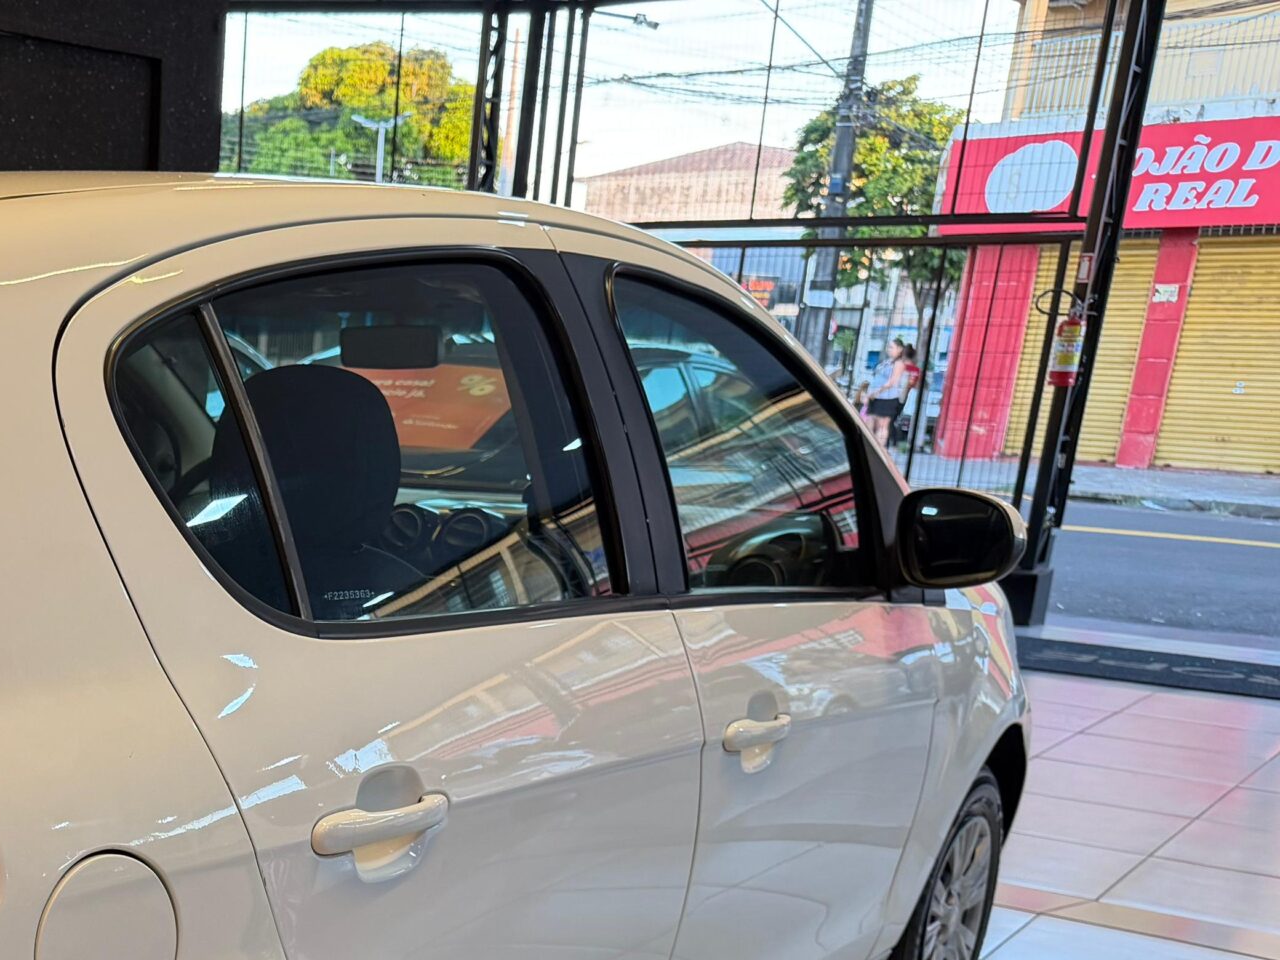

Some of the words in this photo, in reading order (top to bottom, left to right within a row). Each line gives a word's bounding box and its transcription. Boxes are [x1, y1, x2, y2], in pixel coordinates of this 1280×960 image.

[1132, 134, 1241, 177] OJÃO
[1242, 140, 1280, 170] D
[1132, 178, 1260, 212] REAL
